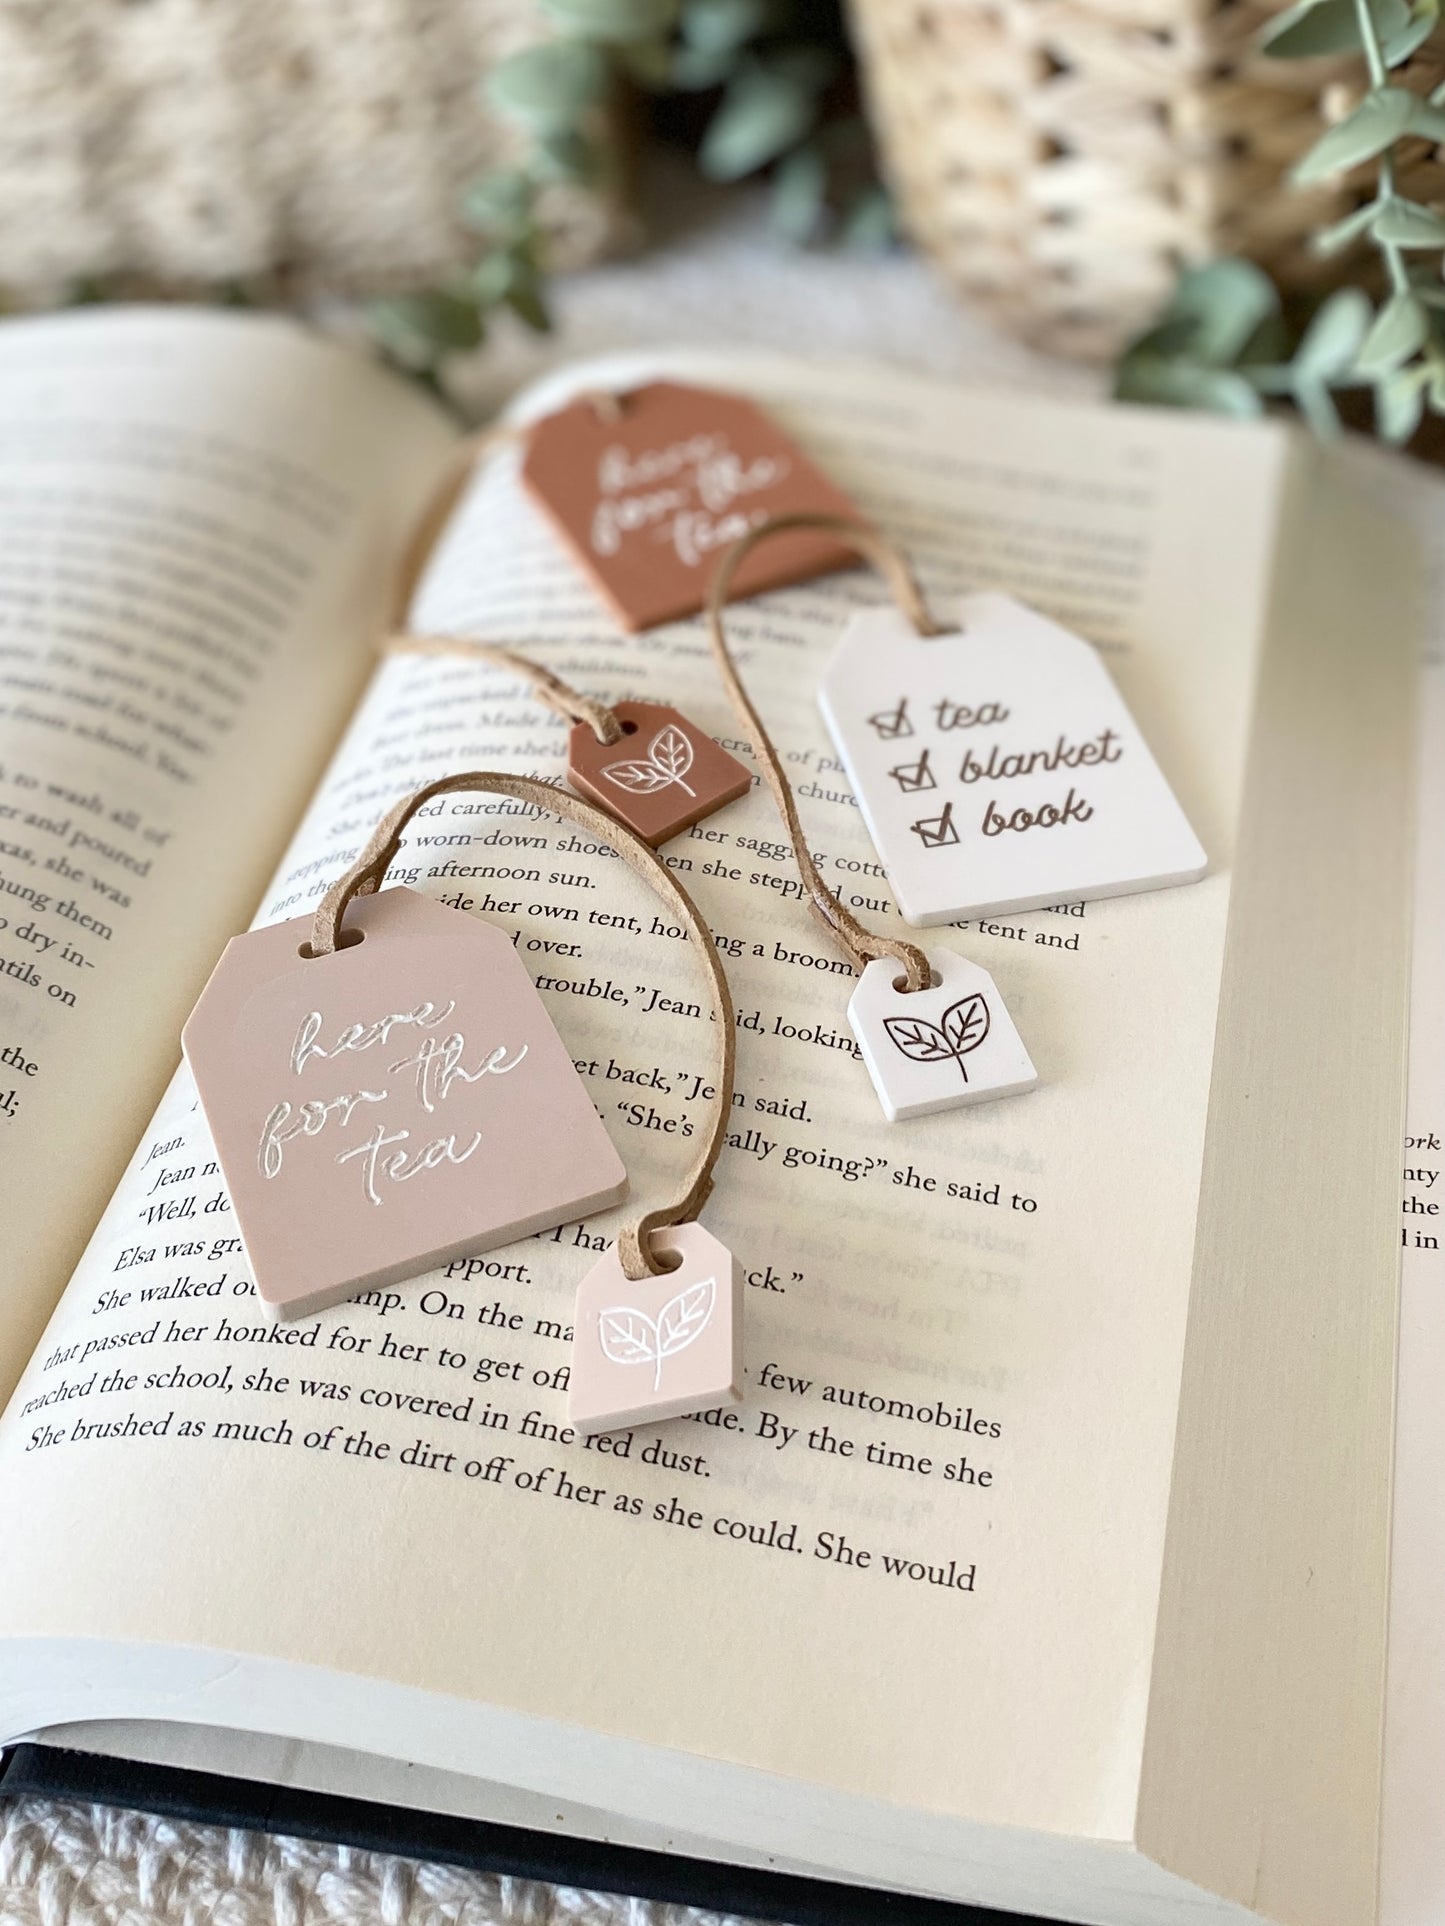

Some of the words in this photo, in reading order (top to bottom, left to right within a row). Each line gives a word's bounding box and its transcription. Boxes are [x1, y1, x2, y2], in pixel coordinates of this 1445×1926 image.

[934, 698, 1010, 731] tea
[788, 750, 811, 763] of
[959, 729, 1123, 784] blanket
[451, 799, 551, 821] carefully,
[690, 825, 728, 844] her
[982, 788, 1093, 837] book
[24, 814, 71, 836] and
[68, 830, 152, 878] poured
[45, 856, 84, 882] she
[91, 876, 132, 908] was
[270, 892, 303, 922] into
[426, 859, 541, 882] afternoon
[548, 872, 596, 889] sun.
[286, 846, 357, 884] stepping
[416, 828, 548, 850] worn-down
[701, 859, 743, 881] she
[749, 871, 842, 901] stepd
[849, 894, 892, 914] out
[978, 919, 1028, 941] tent
[1034, 932, 1080, 951] and
[56, 900, 114, 940] them
[478, 893, 523, 914] her
[527, 903, 580, 922] own
[588, 909, 642, 936] tent,
[751, 943, 765, 958] a
[773, 939, 860, 978] broom.
[15, 922, 58, 953] dry
[60, 942, 95, 969] in-
[526, 938, 583, 959] over.
[47, 983, 77, 1008] on
[642, 988, 701, 1018] Jean
[709, 1006, 768, 1038] sid,
[1, 1047, 38, 1077] the
[290, 1000, 455, 1075] here
[257, 1090, 387, 1179] for
[388, 1033, 528, 1112] the
[685, 1075, 745, 1107] Jen
[754, 1097, 812, 1123] said.
[140, 1136, 186, 1171] Jean.
[335, 1125, 481, 1205] tea
[146, 1165, 196, 1197] Jean
[891, 1165, 937, 1193] she
[947, 1174, 1000, 1206] said
[1010, 1193, 1038, 1214] to
[112, 1245, 157, 1273] Elsa
[164, 1240, 207, 1259] was
[1415, 1231, 1440, 1250] in
[91, 1288, 132, 1315] She
[140, 1272, 228, 1303] walked
[419, 1290, 465, 1321] On
[477, 1301, 524, 1331] the
[756, 1362, 814, 1396] few
[821, 1385, 1002, 1439] automobiles
[19, 1371, 99, 1418] reached
[99, 1368, 139, 1394] the
[143, 1363, 234, 1395] school,
[241, 1366, 290, 1394] she
[299, 1379, 352, 1402] was
[359, 1388, 475, 1423] covered
[478, 1402, 509, 1431] in
[516, 1410, 576, 1446] fine
[582, 1433, 632, 1458] red
[640, 1438, 711, 1478] dust.
[42, 1344, 81, 1372] that
[77, 1320, 162, 1364] passed
[162, 1319, 210, 1343] her
[212, 1317, 322, 1347] honked
[325, 1325, 373, 1354] for
[377, 1332, 430, 1363] her
[437, 1347, 467, 1370] to
[472, 1357, 525, 1384] get
[754, 1410, 800, 1451] By
[807, 1425, 855, 1458] the
[865, 1440, 933, 1476] time
[943, 1456, 993, 1488] she
[24, 1424, 66, 1452] She
[69, 1410, 175, 1442] brushed
[176, 1420, 207, 1438] as
[211, 1418, 294, 1446] much
[303, 1425, 345, 1451] of
[343, 1429, 391, 1461] the
[399, 1439, 458, 1473] dirt
[463, 1455, 516, 1484] off
[514, 1466, 556, 1493] of
[552, 1470, 607, 1507] her
[612, 1494, 644, 1516] as
[652, 1496, 704, 1530] she
[712, 1517, 803, 1555] could.
[813, 1531, 872, 1569] She
[880, 1555, 977, 1592] would
